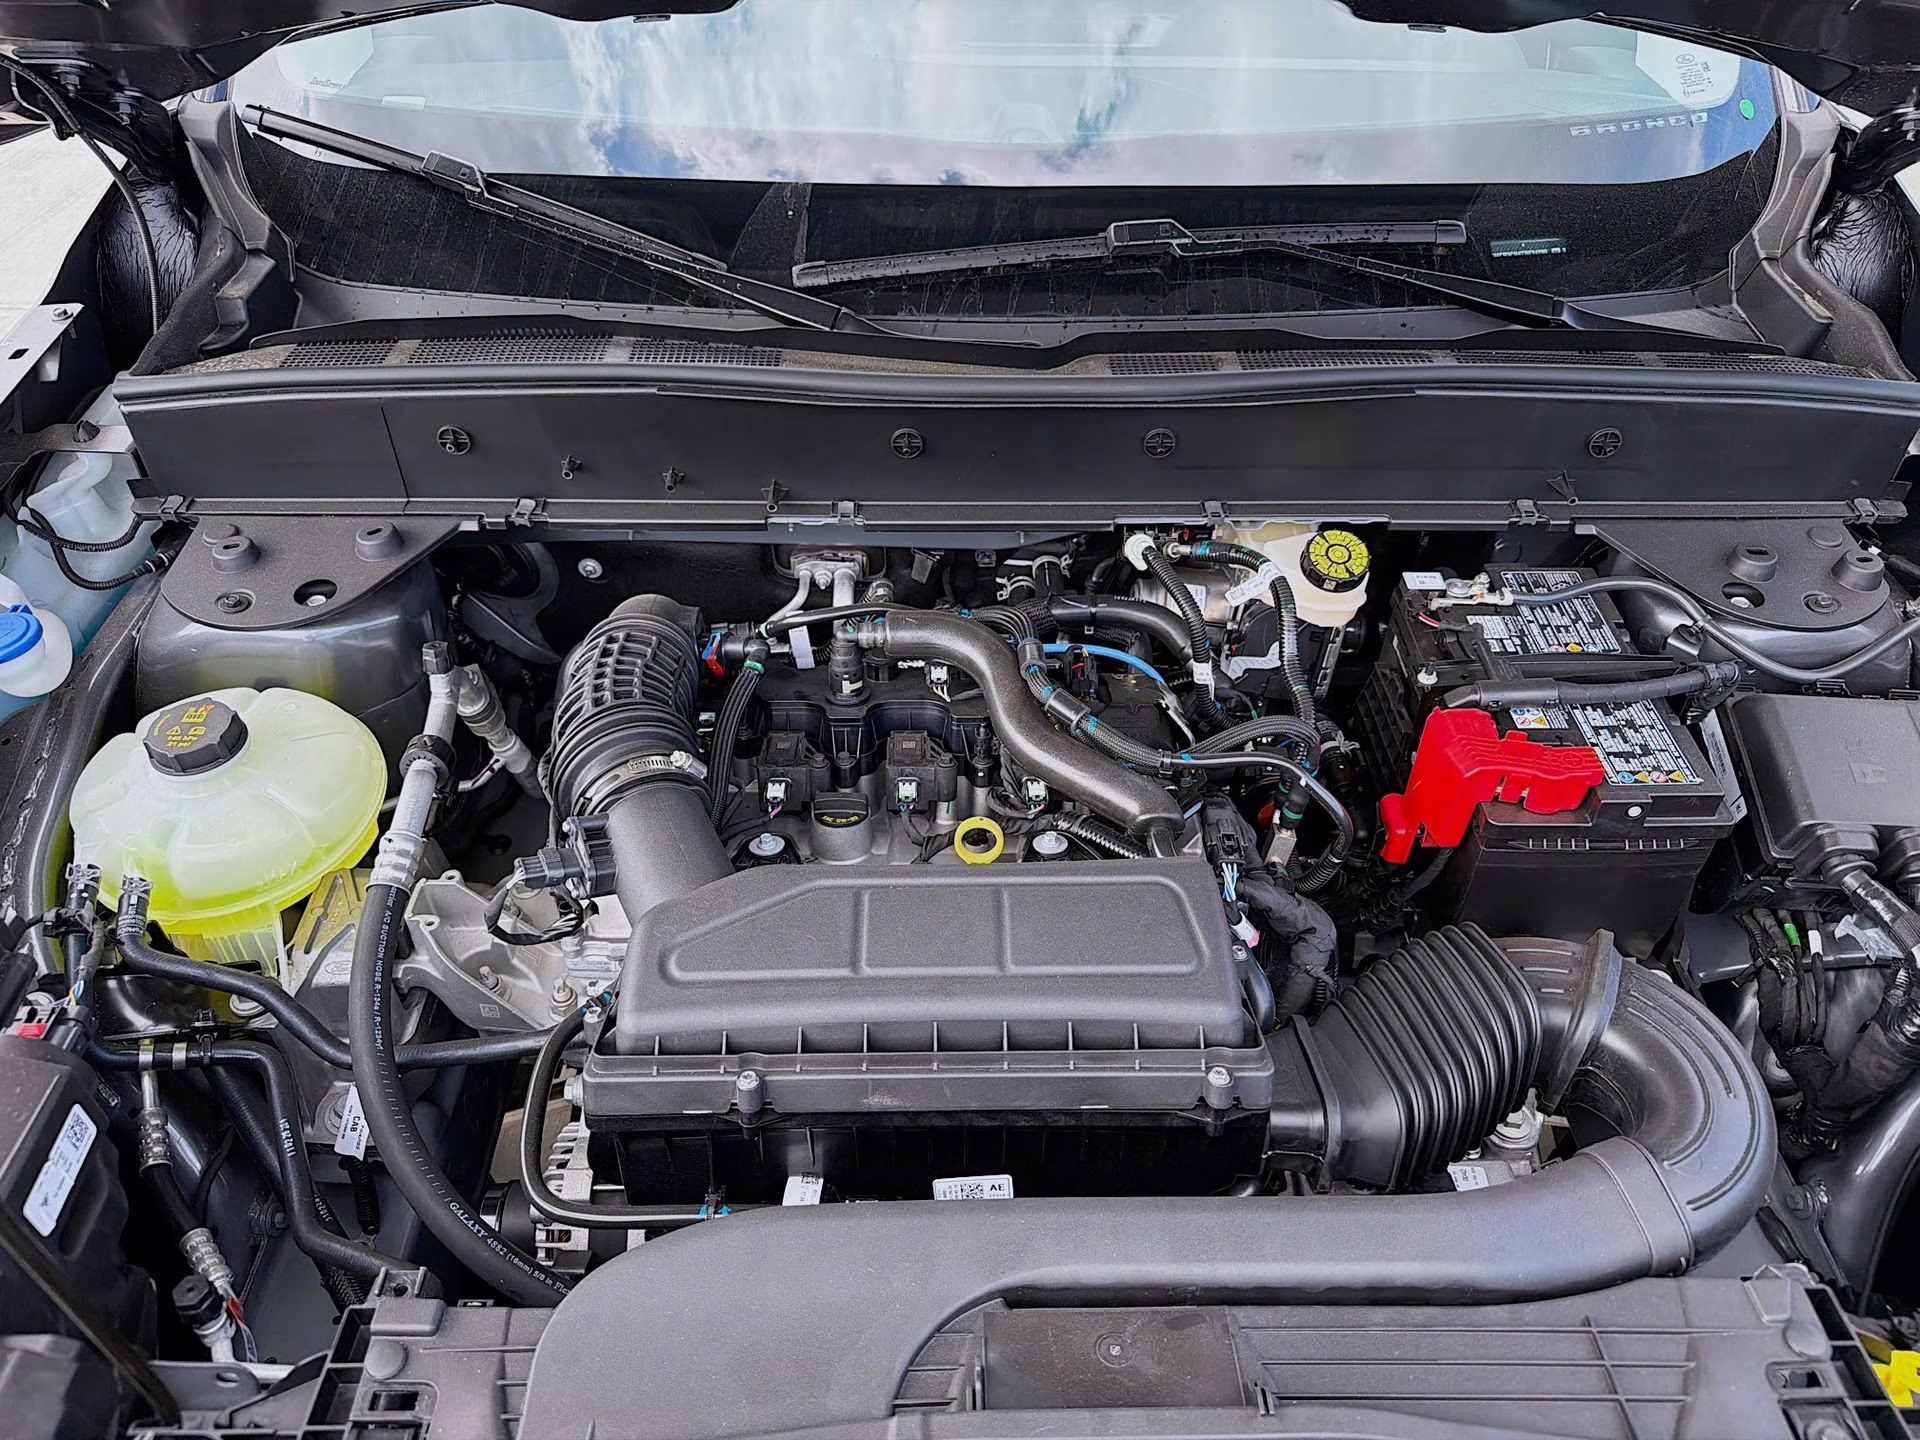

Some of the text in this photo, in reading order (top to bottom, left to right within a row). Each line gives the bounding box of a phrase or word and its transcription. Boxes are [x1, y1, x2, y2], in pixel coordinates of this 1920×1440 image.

[1570, 112, 1708, 136] BRONCO
[376, 924, 389, 958] SUCTION
[374, 959, 385, 982] HOSE
[373, 983, 382, 1011] R-134a
[350, 1115, 361, 1133] CAB
[989, 1182, 1006, 1192] AE
[449, 1202, 488, 1238] GALAXY
[486, 1237, 507, 1256] 4882
[506, 1253, 534, 1275] (16mm)
